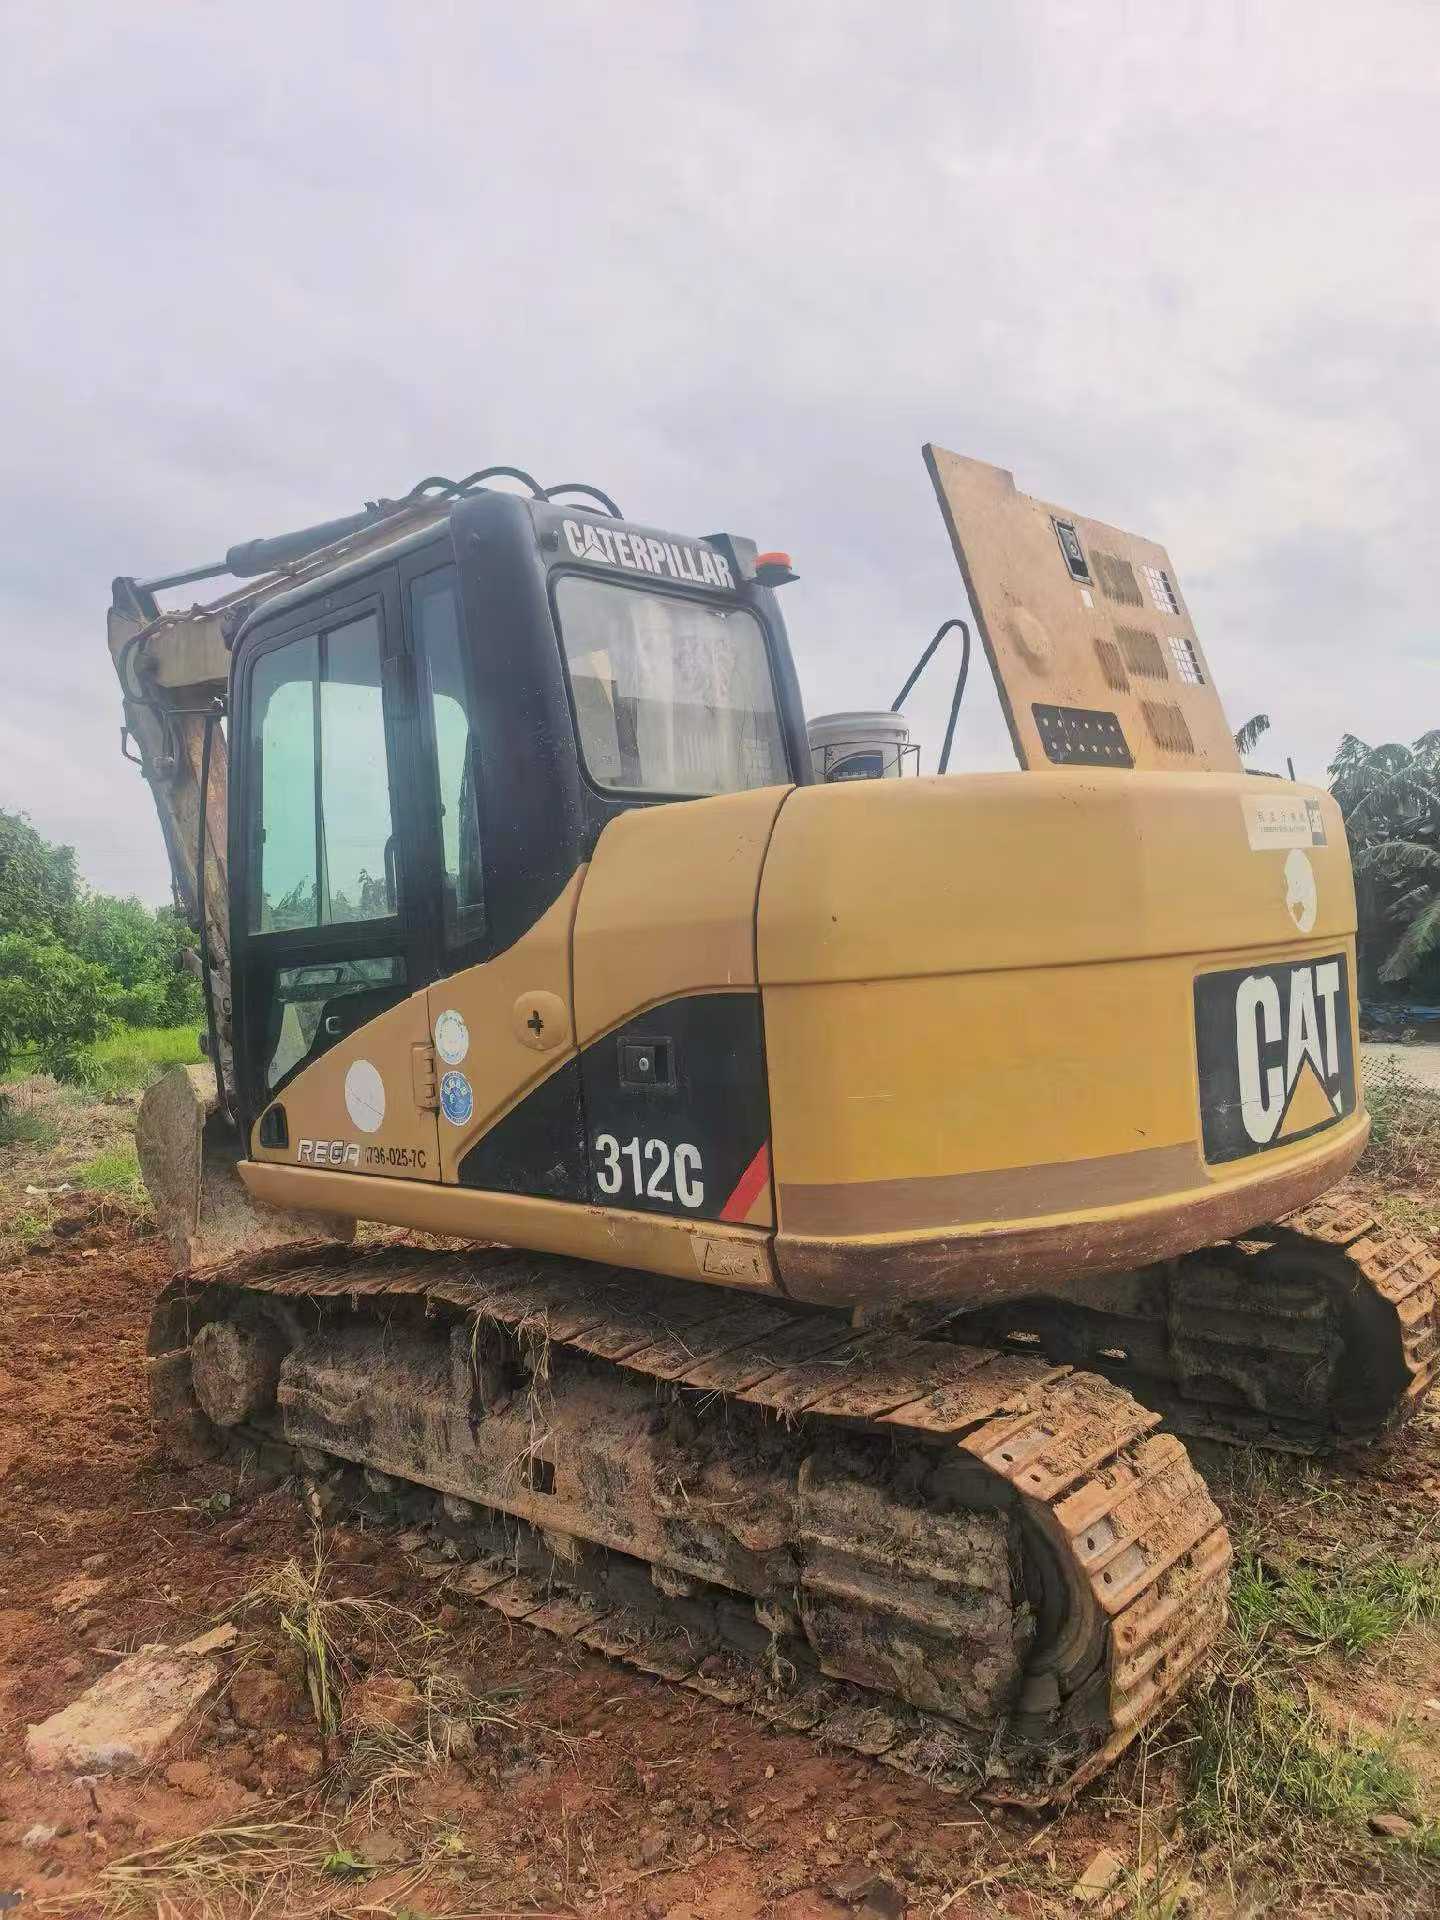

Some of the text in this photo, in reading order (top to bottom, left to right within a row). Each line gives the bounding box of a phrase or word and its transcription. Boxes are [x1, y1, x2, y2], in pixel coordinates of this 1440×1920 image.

[563, 520, 736, 590] CATERPILLAR
[1236, 962, 1341, 1143] CAT
[297, 1139, 361, 1167] REGA
[595, 1133, 704, 1208] 312C
